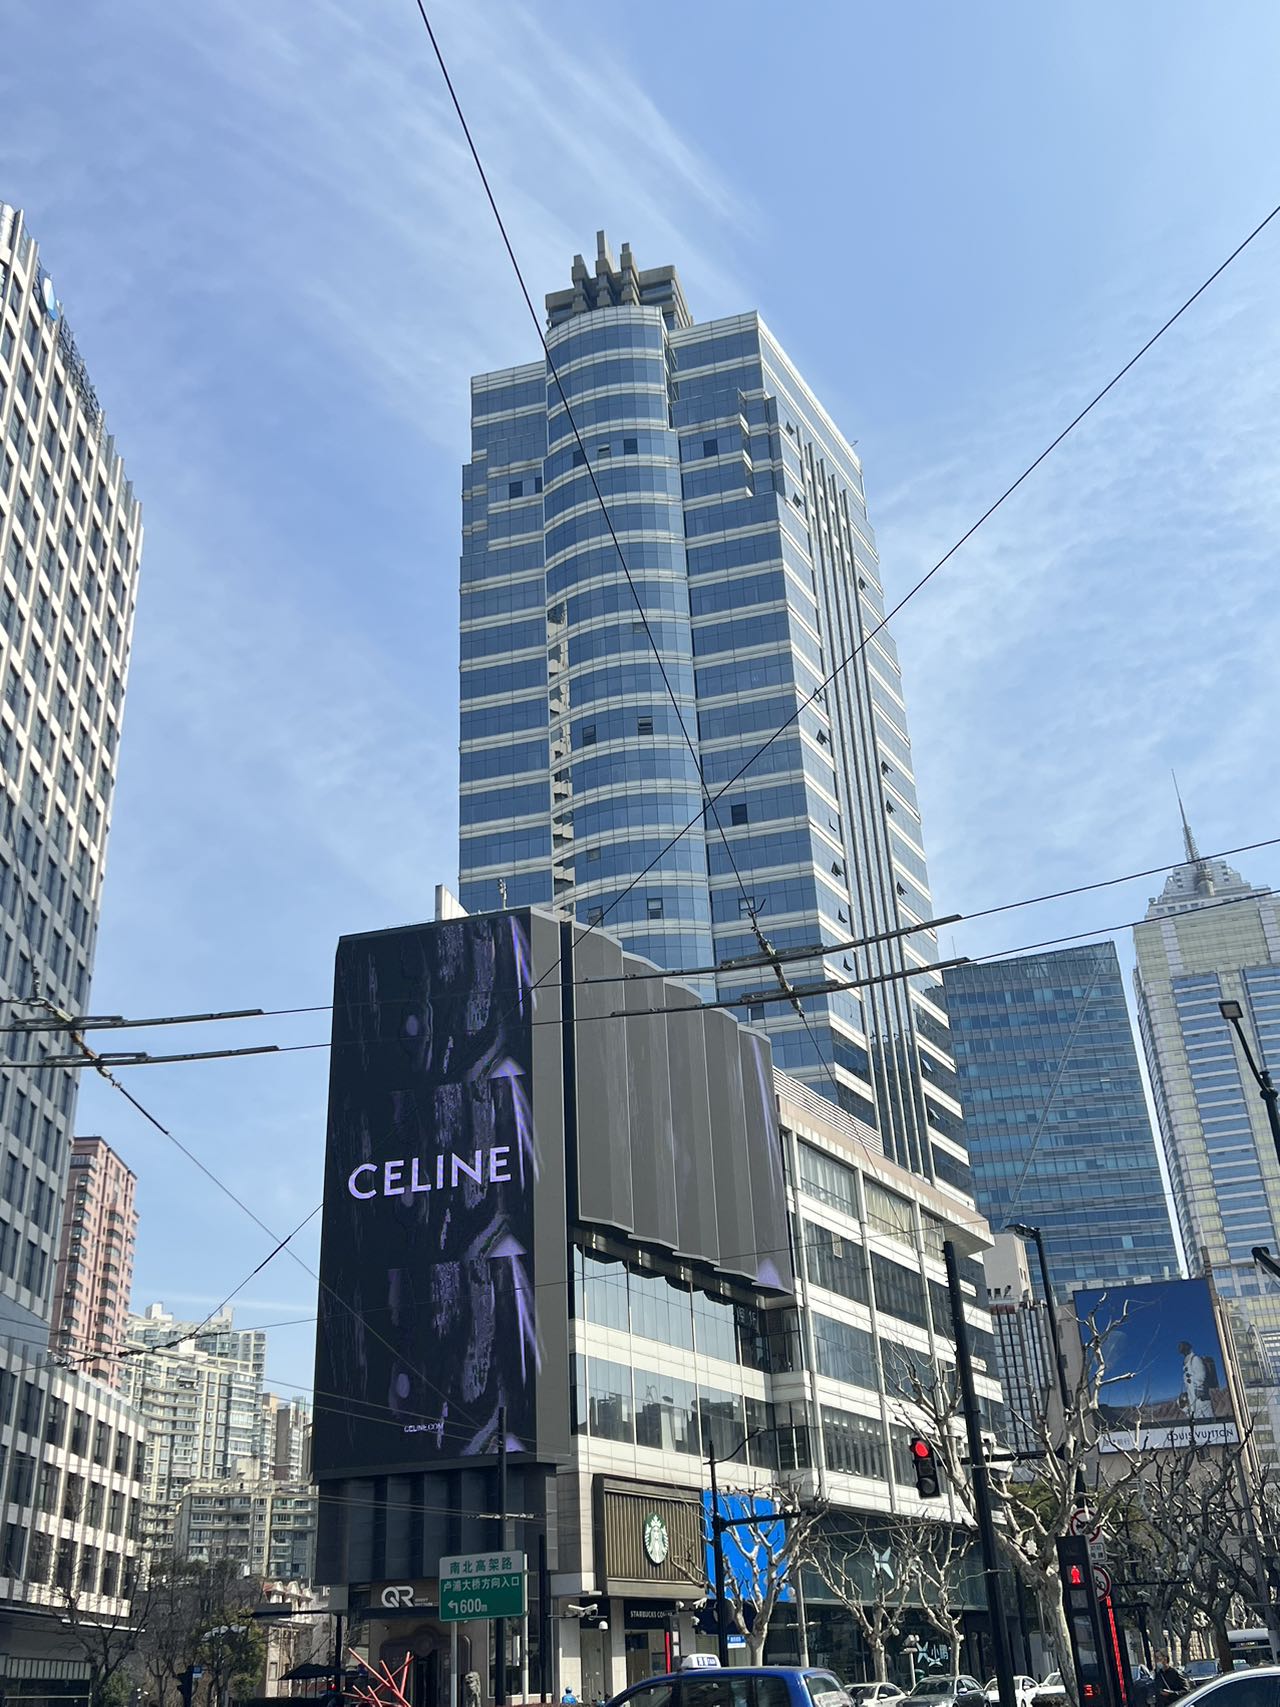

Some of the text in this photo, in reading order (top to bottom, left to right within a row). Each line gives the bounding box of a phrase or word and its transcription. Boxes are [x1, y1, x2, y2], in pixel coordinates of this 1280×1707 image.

[348, 1146, 511, 1200] CELINE
[1195, 1429, 1233, 1439] VUTTON
[450, 1557, 512, 1575] 南北高架路
[443, 1576, 520, 1593] 卢浦大桥方向入口
[381, 1586, 414, 1608] QR
[460, 1598, 488, 1614] 600m
[630, 1610, 657, 1619] STARBUCKS
